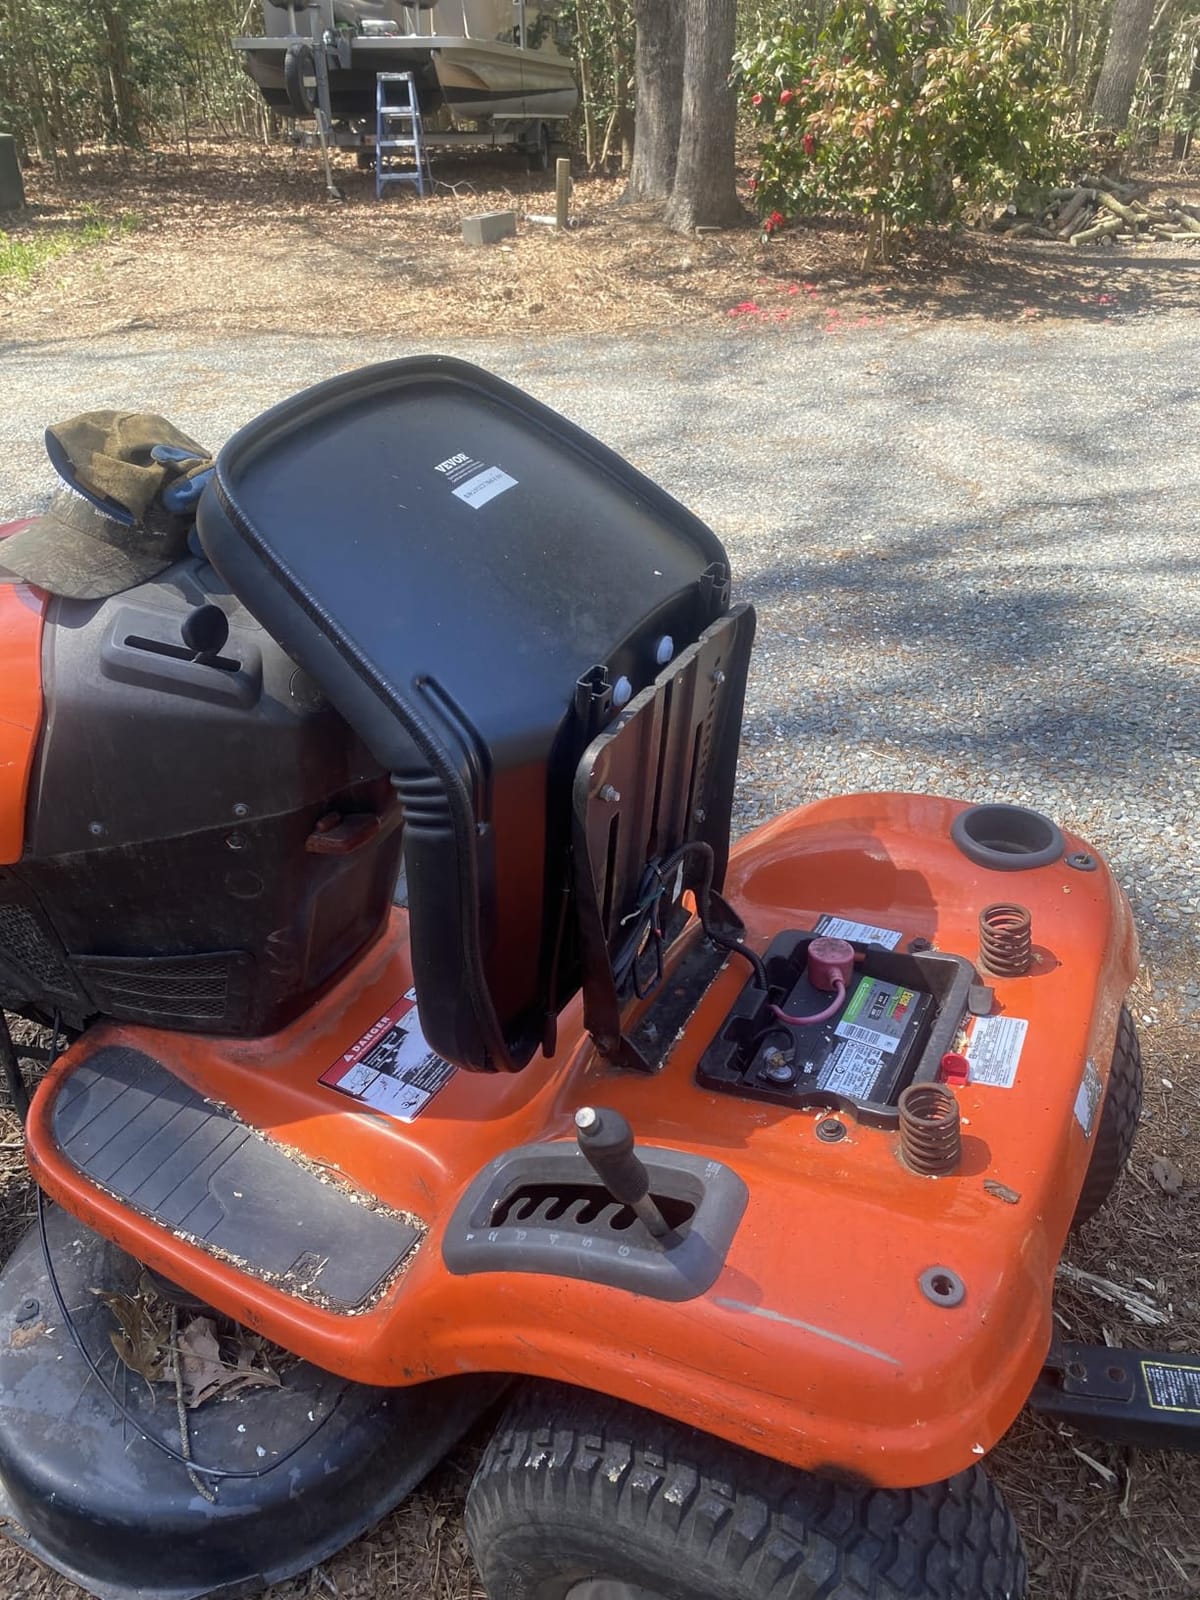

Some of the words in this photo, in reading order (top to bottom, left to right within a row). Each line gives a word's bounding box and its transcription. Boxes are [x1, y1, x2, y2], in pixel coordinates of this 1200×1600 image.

[434, 452, 469, 472] VEVOR
[352, 1016, 390, 1052] DANGER
[617, 1244, 630, 1257] 6
